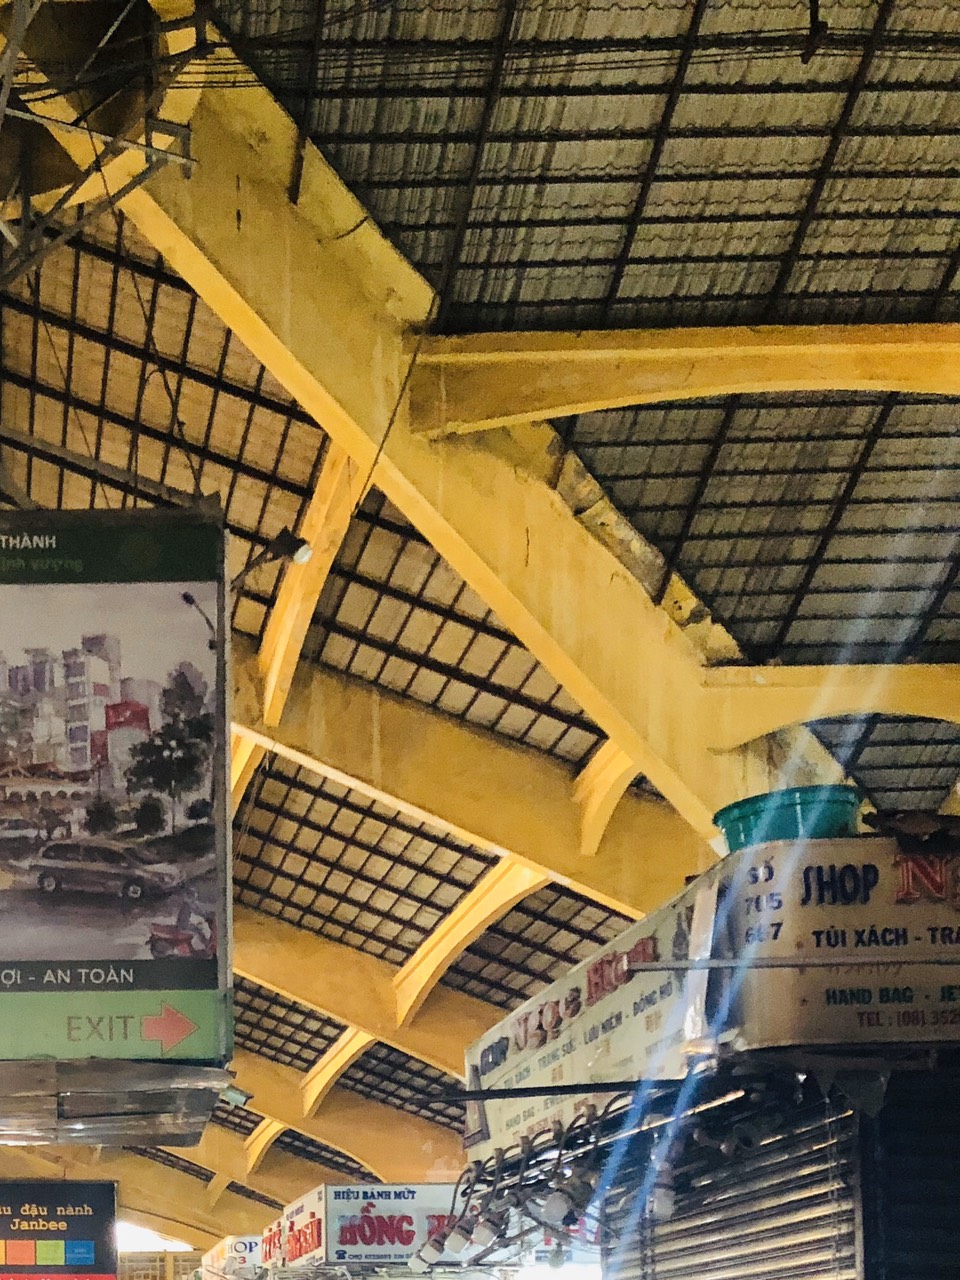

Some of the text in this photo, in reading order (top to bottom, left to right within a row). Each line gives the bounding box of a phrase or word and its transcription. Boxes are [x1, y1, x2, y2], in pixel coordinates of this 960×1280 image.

[801, 854, 960, 906] SHOP N
[811, 925, 847, 948] TÚI
[854, 924, 908, 948] XÁCH
[43, 968, 71, 984] AN
[77, 965, 134, 984] TOÀN
[825, 987, 872, 1006] HAND
[878, 986, 914, 1004] BAG
[66, 1015, 135, 1042] EXIT
[10, 1218, 68, 1231] Janbee
